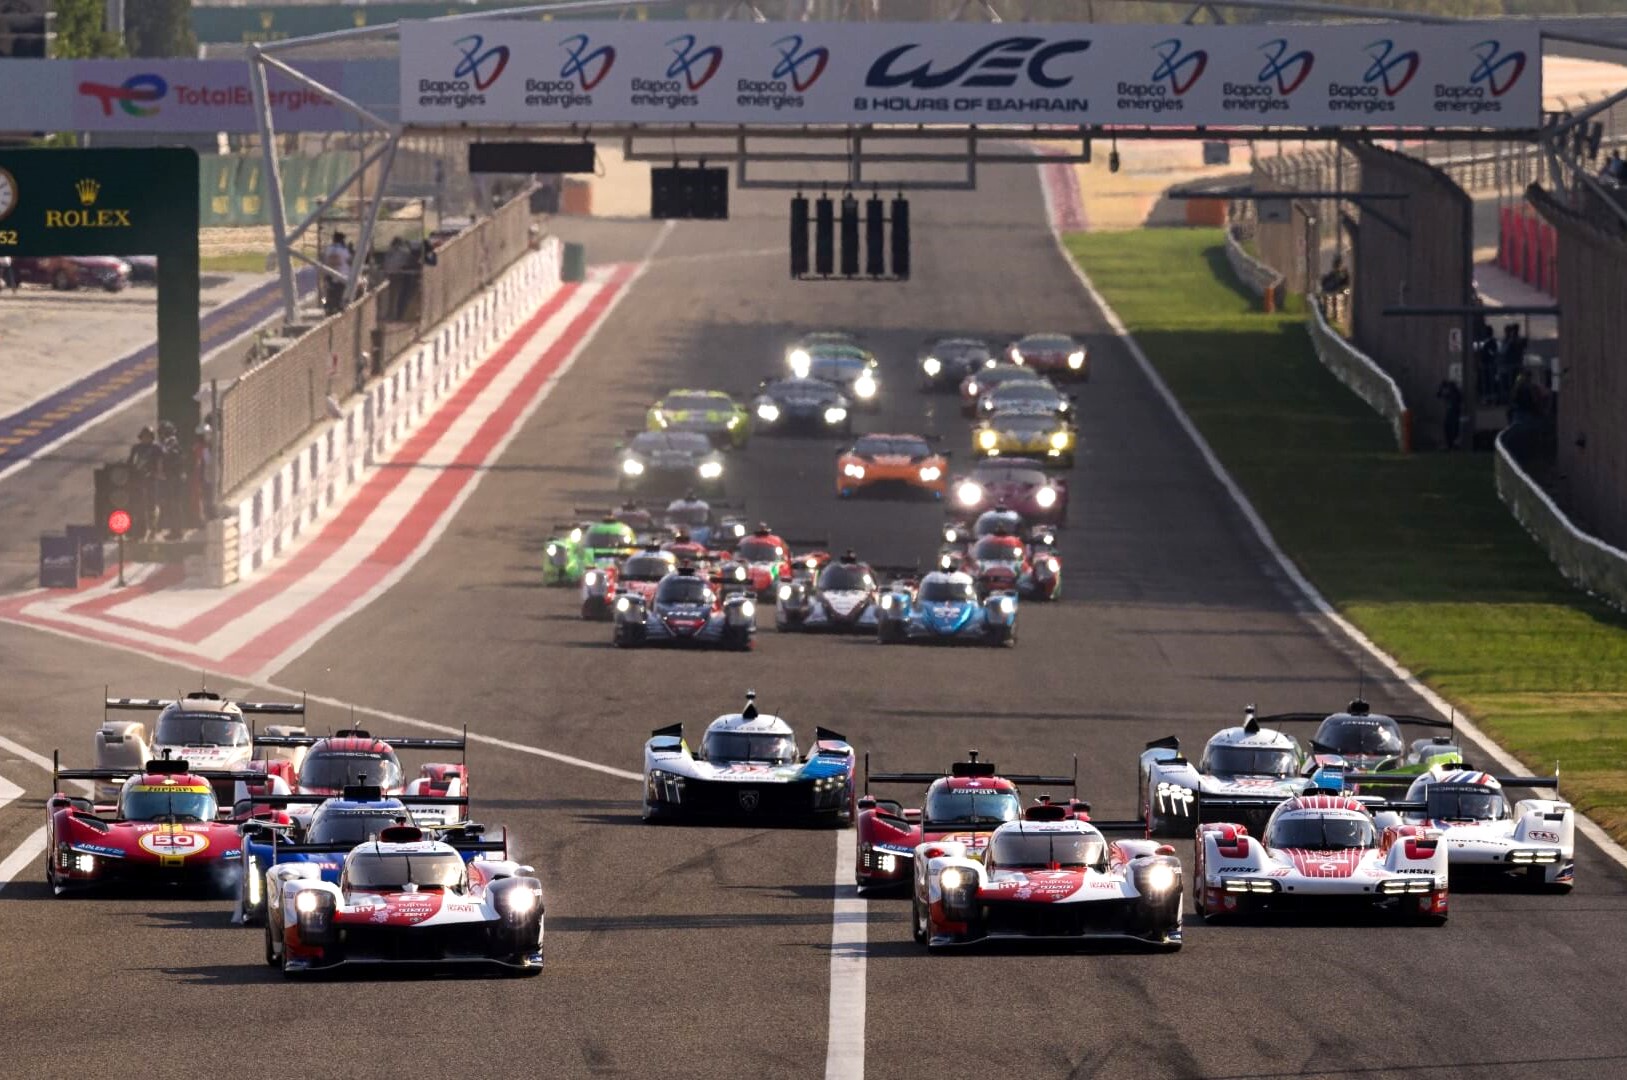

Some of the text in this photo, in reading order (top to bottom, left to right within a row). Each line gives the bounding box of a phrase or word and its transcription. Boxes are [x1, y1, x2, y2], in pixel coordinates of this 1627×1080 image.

[864, 36, 1092, 89] WEC
[419, 79, 469, 93] Bapco
[525, 79, 575, 93] Bapco
[631, 79, 681, 93] Bapco
[737, 80, 787, 94] Bapco
[1117, 82, 1167, 96] Bapco
[1222, 83, 1273, 97] Bapco
[1328, 83, 1379, 98] Bapco
[1434, 84, 1484, 98] Bapco
[419, 95, 486, 108] energies
[525, 95, 592, 108] energies
[631, 95, 698, 109] energies
[737, 96, 804, 110] energies
[854, 97, 1089, 112] 8 HOURS OF BAHRAIN
[1117, 98, 1184, 112] energies
[1222, 99, 1290, 113] energies
[1328, 99, 1396, 113] energies
[1434, 101, 1502, 114] energies
[46, 210, 131, 228] ROLEX
[952, 787, 999, 795] Ferrari
[79, 843, 107, 852] ADLER
[154, 835, 192, 846] 50
[881, 843, 909, 852] ADLER
